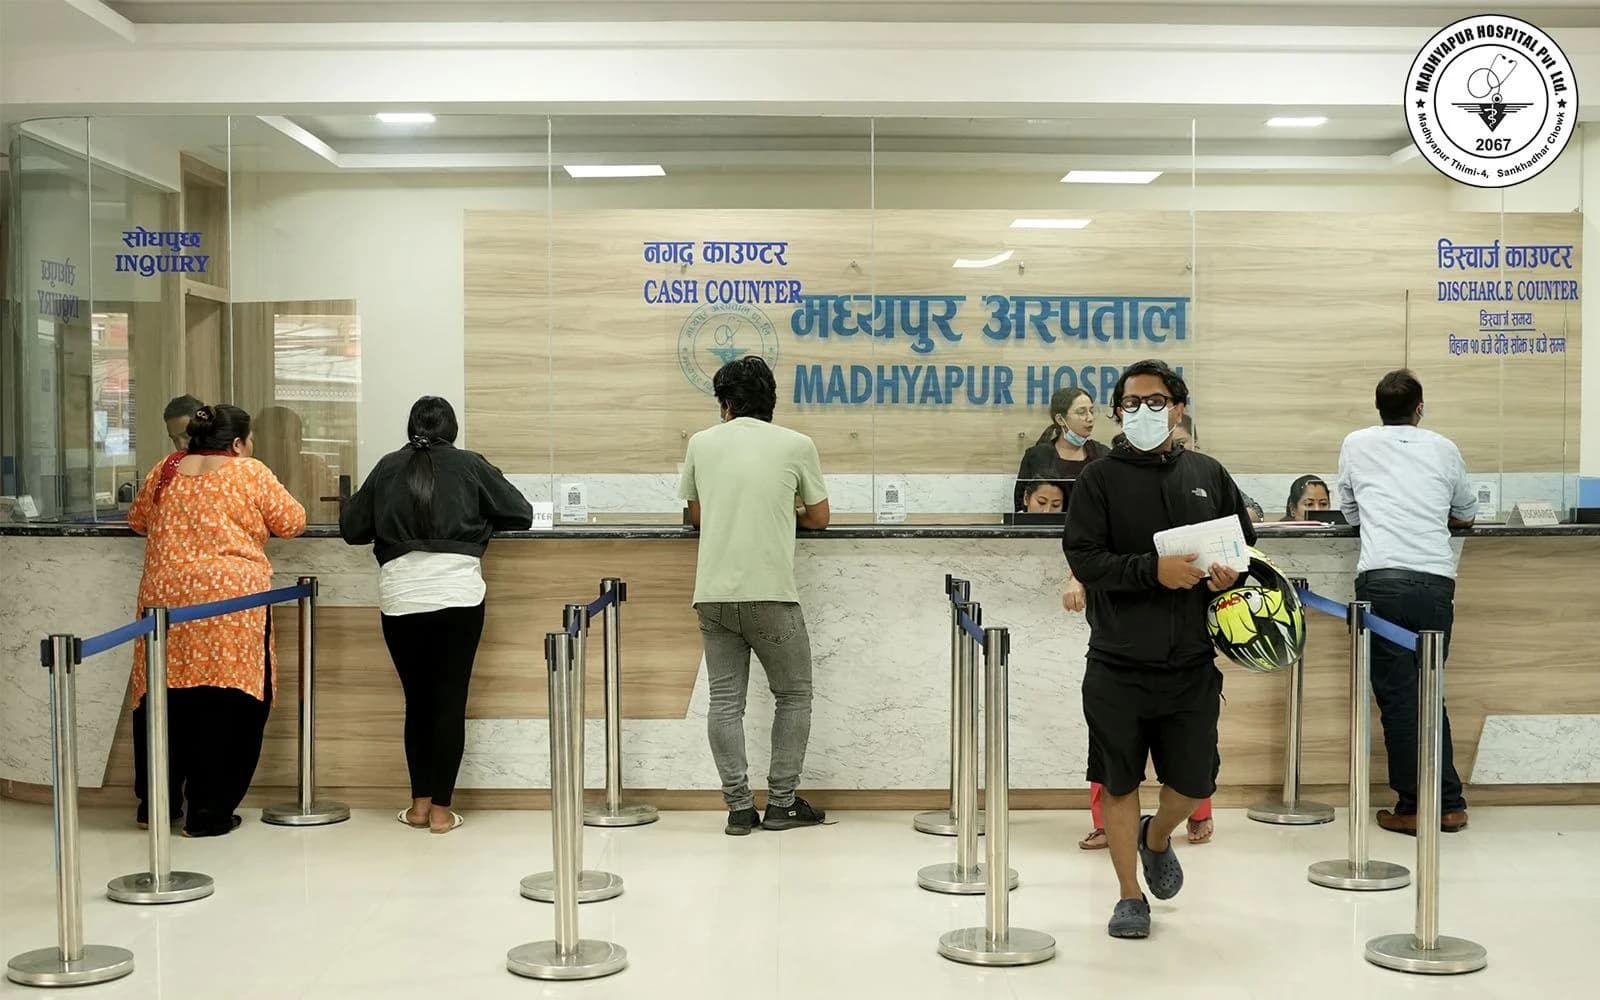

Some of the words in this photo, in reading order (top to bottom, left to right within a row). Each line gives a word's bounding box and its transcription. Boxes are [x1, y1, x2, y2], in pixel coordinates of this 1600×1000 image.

[115, 254, 210, 277] INQUIRY
[643, 241, 695, 265] नगद
[703, 241, 788, 266] काउण्टर
[1438, 238, 1500, 270] डिस्चार्ज
[1505, 245, 1573, 269] काउण्टर
[643, 280, 698, 304] CASH
[705, 280, 804, 304] COUNTER
[1517, 280, 1579, 300] COUNTER
[790, 294, 967, 354] मध्यपुर
[982, 294, 1191, 344] अस्पताल
[792, 364, 1014, 404] MADHYAPUR
[1026, 364, 1190, 405] HOSP
